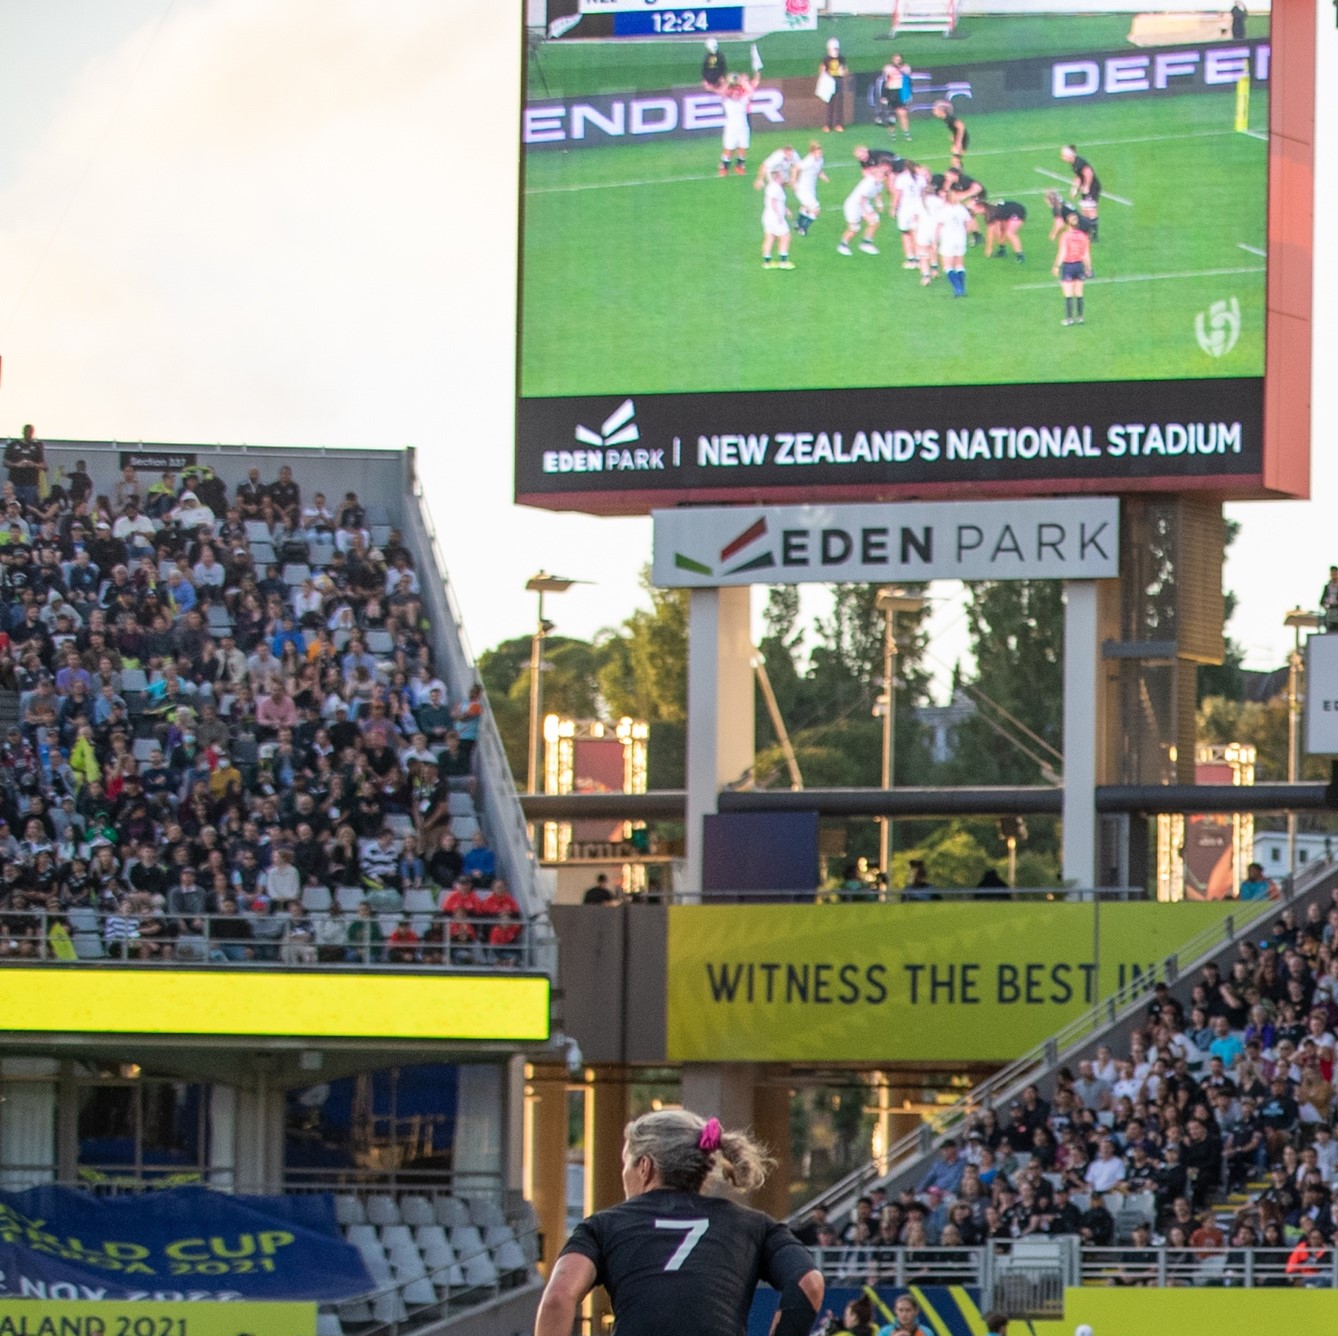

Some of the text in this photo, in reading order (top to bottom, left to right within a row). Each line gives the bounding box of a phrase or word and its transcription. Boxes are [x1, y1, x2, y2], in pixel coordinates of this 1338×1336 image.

[651, 11, 710, 32] 12:24
[543, 449, 664, 473] EDEN PARK
[698, 421, 1242, 466] NEW ZEALAND'S NATIONAL STADIUM
[782, 522, 1110, 567] EDEN PARK
[706, 963, 888, 1005] WITNESS
[904, 963, 980, 1004] THE
[998, 963, 1097, 1005] BEST
[165, 1231, 296, 1261] CUP
[655, 1218, 710, 1271] 7
